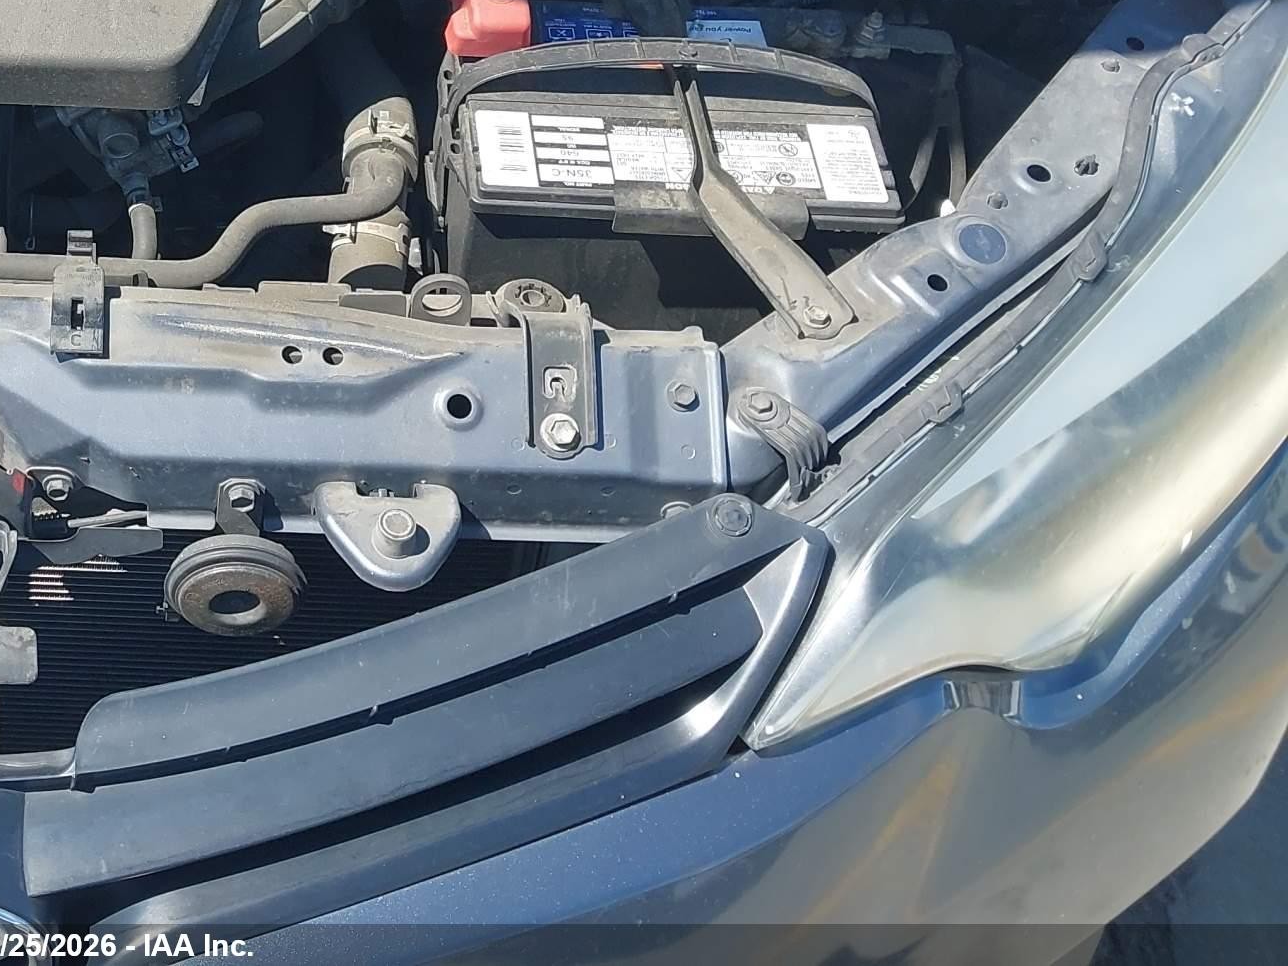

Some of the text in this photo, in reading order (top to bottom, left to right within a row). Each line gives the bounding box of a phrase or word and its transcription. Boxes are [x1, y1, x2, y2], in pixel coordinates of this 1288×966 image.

[705, 26, 722, 34] you
[724, 26, 752, 34] Power
[551, 168, 593, 178] 35N-C
